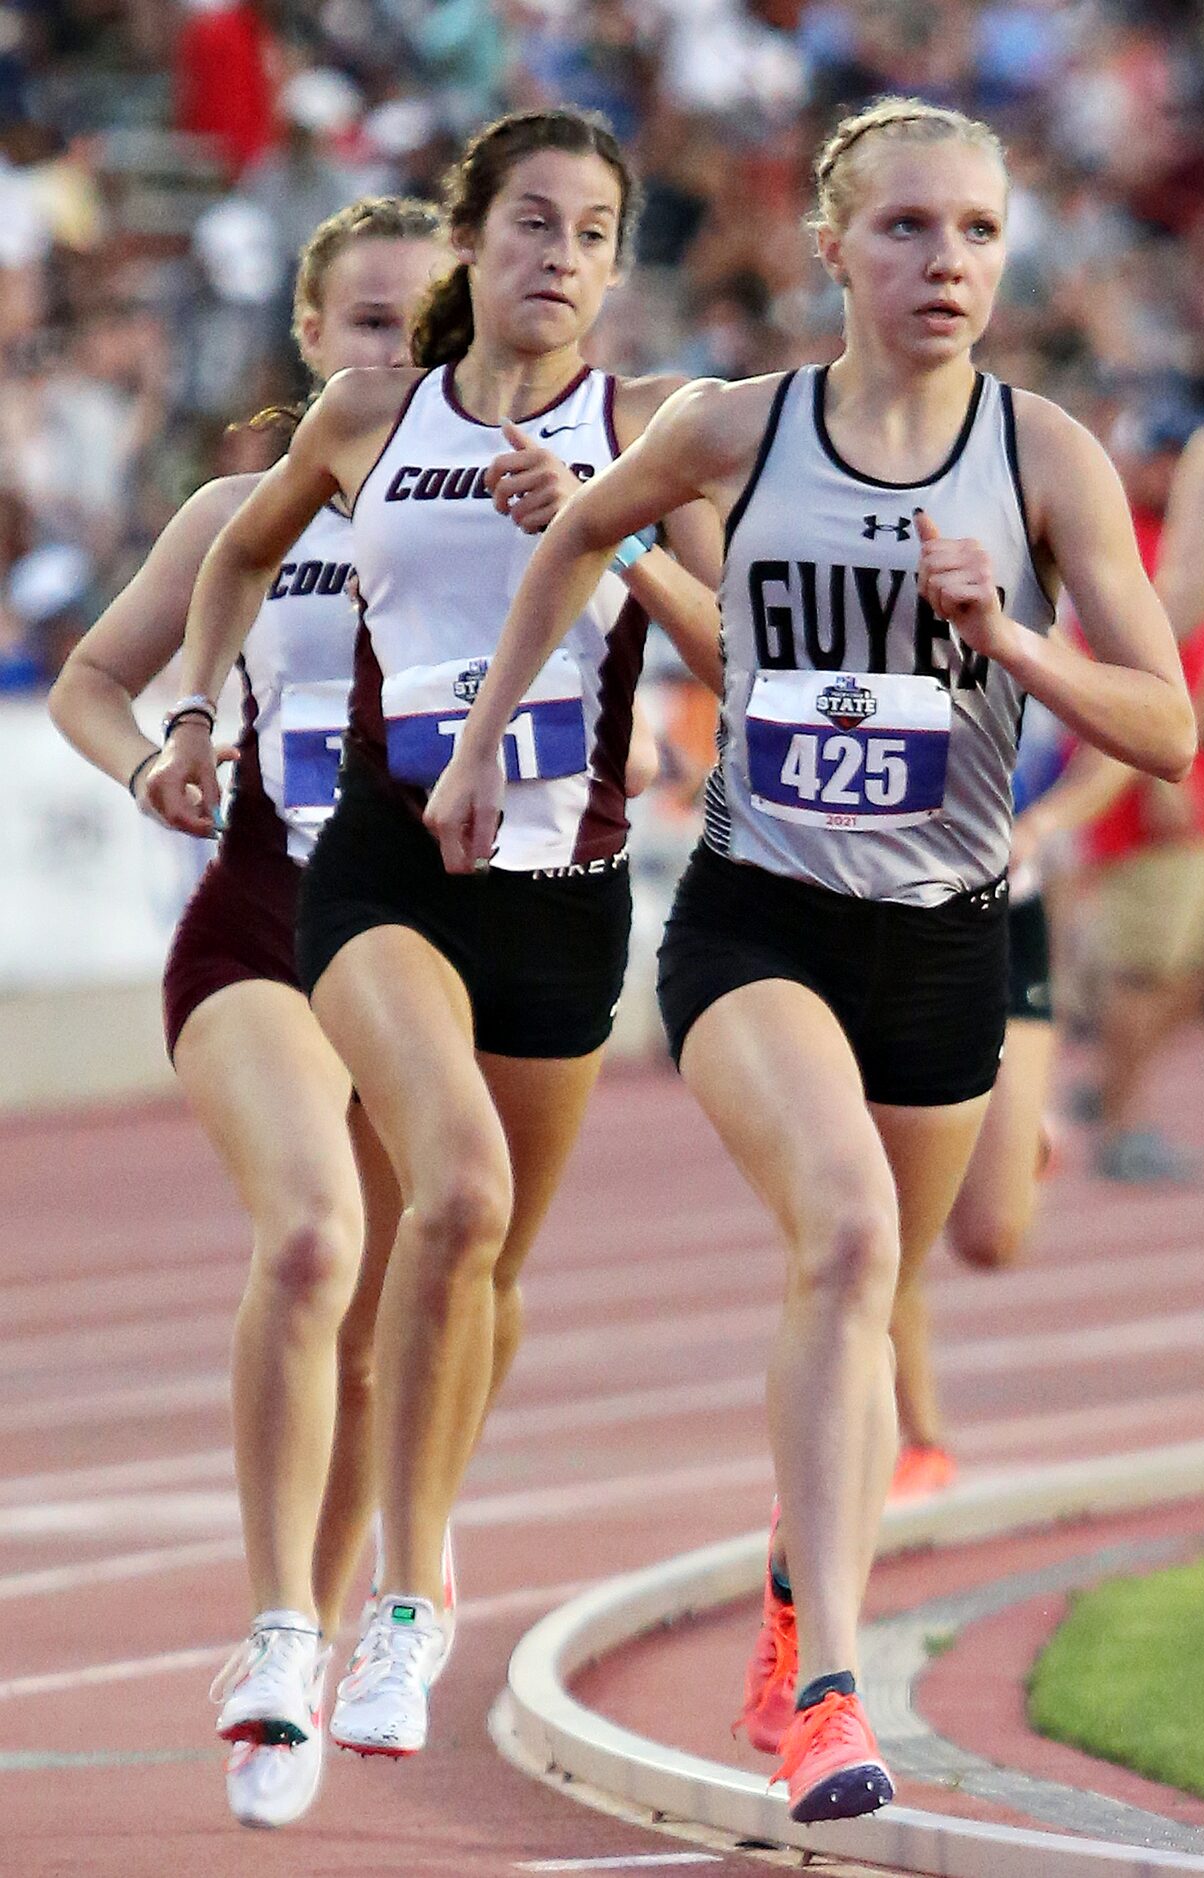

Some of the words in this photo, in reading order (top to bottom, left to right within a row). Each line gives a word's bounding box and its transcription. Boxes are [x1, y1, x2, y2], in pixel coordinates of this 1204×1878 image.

[817, 696, 876, 713] STATE
[437, 711, 538, 780] 71
[780, 733, 908, 807] 425
[826, 815, 857, 826] 2021
